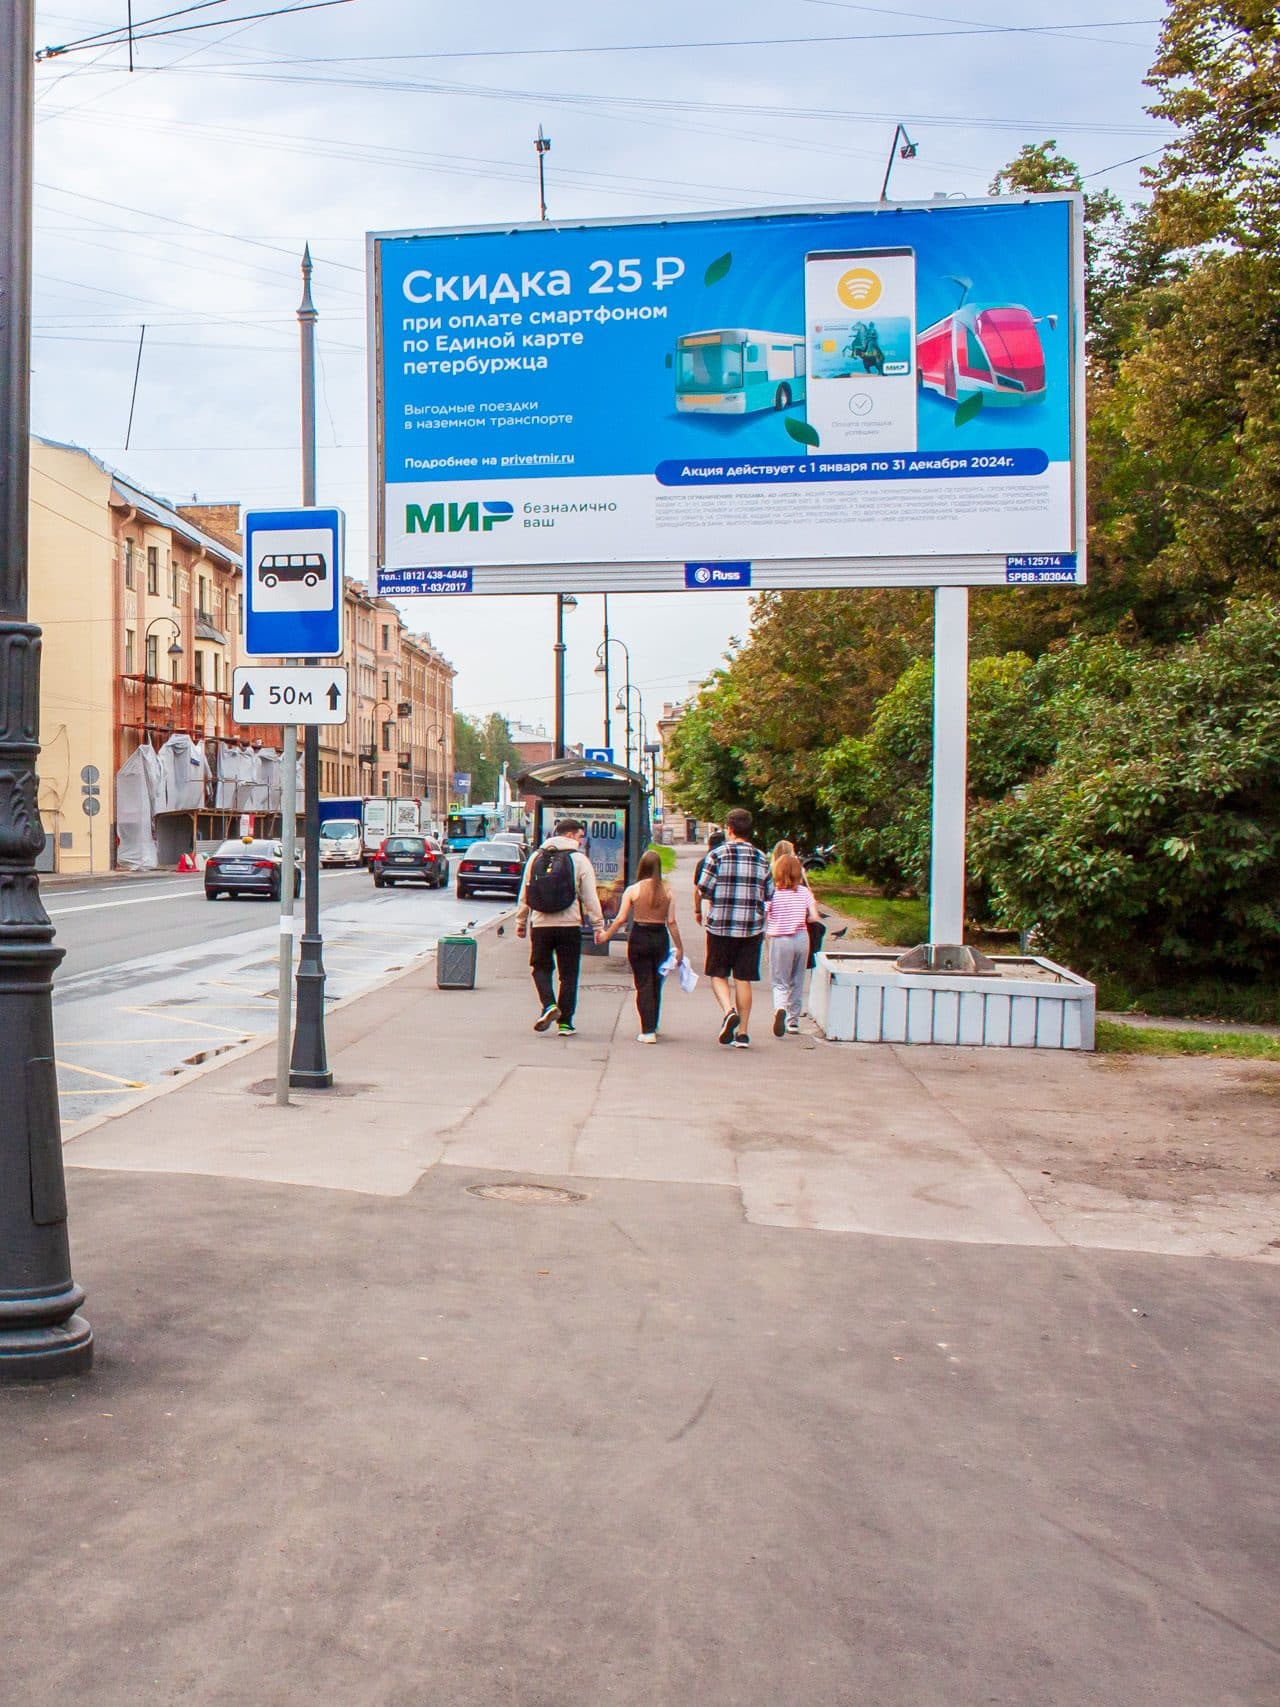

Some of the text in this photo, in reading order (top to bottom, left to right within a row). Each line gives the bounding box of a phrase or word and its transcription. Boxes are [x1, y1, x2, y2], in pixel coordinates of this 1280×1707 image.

[402, 269, 571, 304] Скидка
[588, 258, 643, 294] 25
[403, 305, 668, 333] при оплате смартфоном
[403, 331, 584, 353] по Единой карте
[403, 354, 548, 375] петербуржца
[404, 401, 539, 416] Выгодные поездки
[404, 414, 573, 430] в наземном транспорте
[404, 453, 575, 470] Подробнее на privetmir.ru
[681, 465, 723, 478] Акция
[726, 463, 796, 477] действует
[809, 462, 816, 473] 1
[819, 462, 867, 474] января
[871, 461, 889, 471] по
[892, 459, 906, 470] 31
[909, 458, 968, 472] декабря
[971, 456, 1015, 469] 2024г.
[405, 501, 617, 533] МИР безналично
[523, 518, 555, 528] ваш
[403, 571, 425, 582] (812)
[713, 570, 740, 580] Russ
[380, 585, 419, 594] договор:
